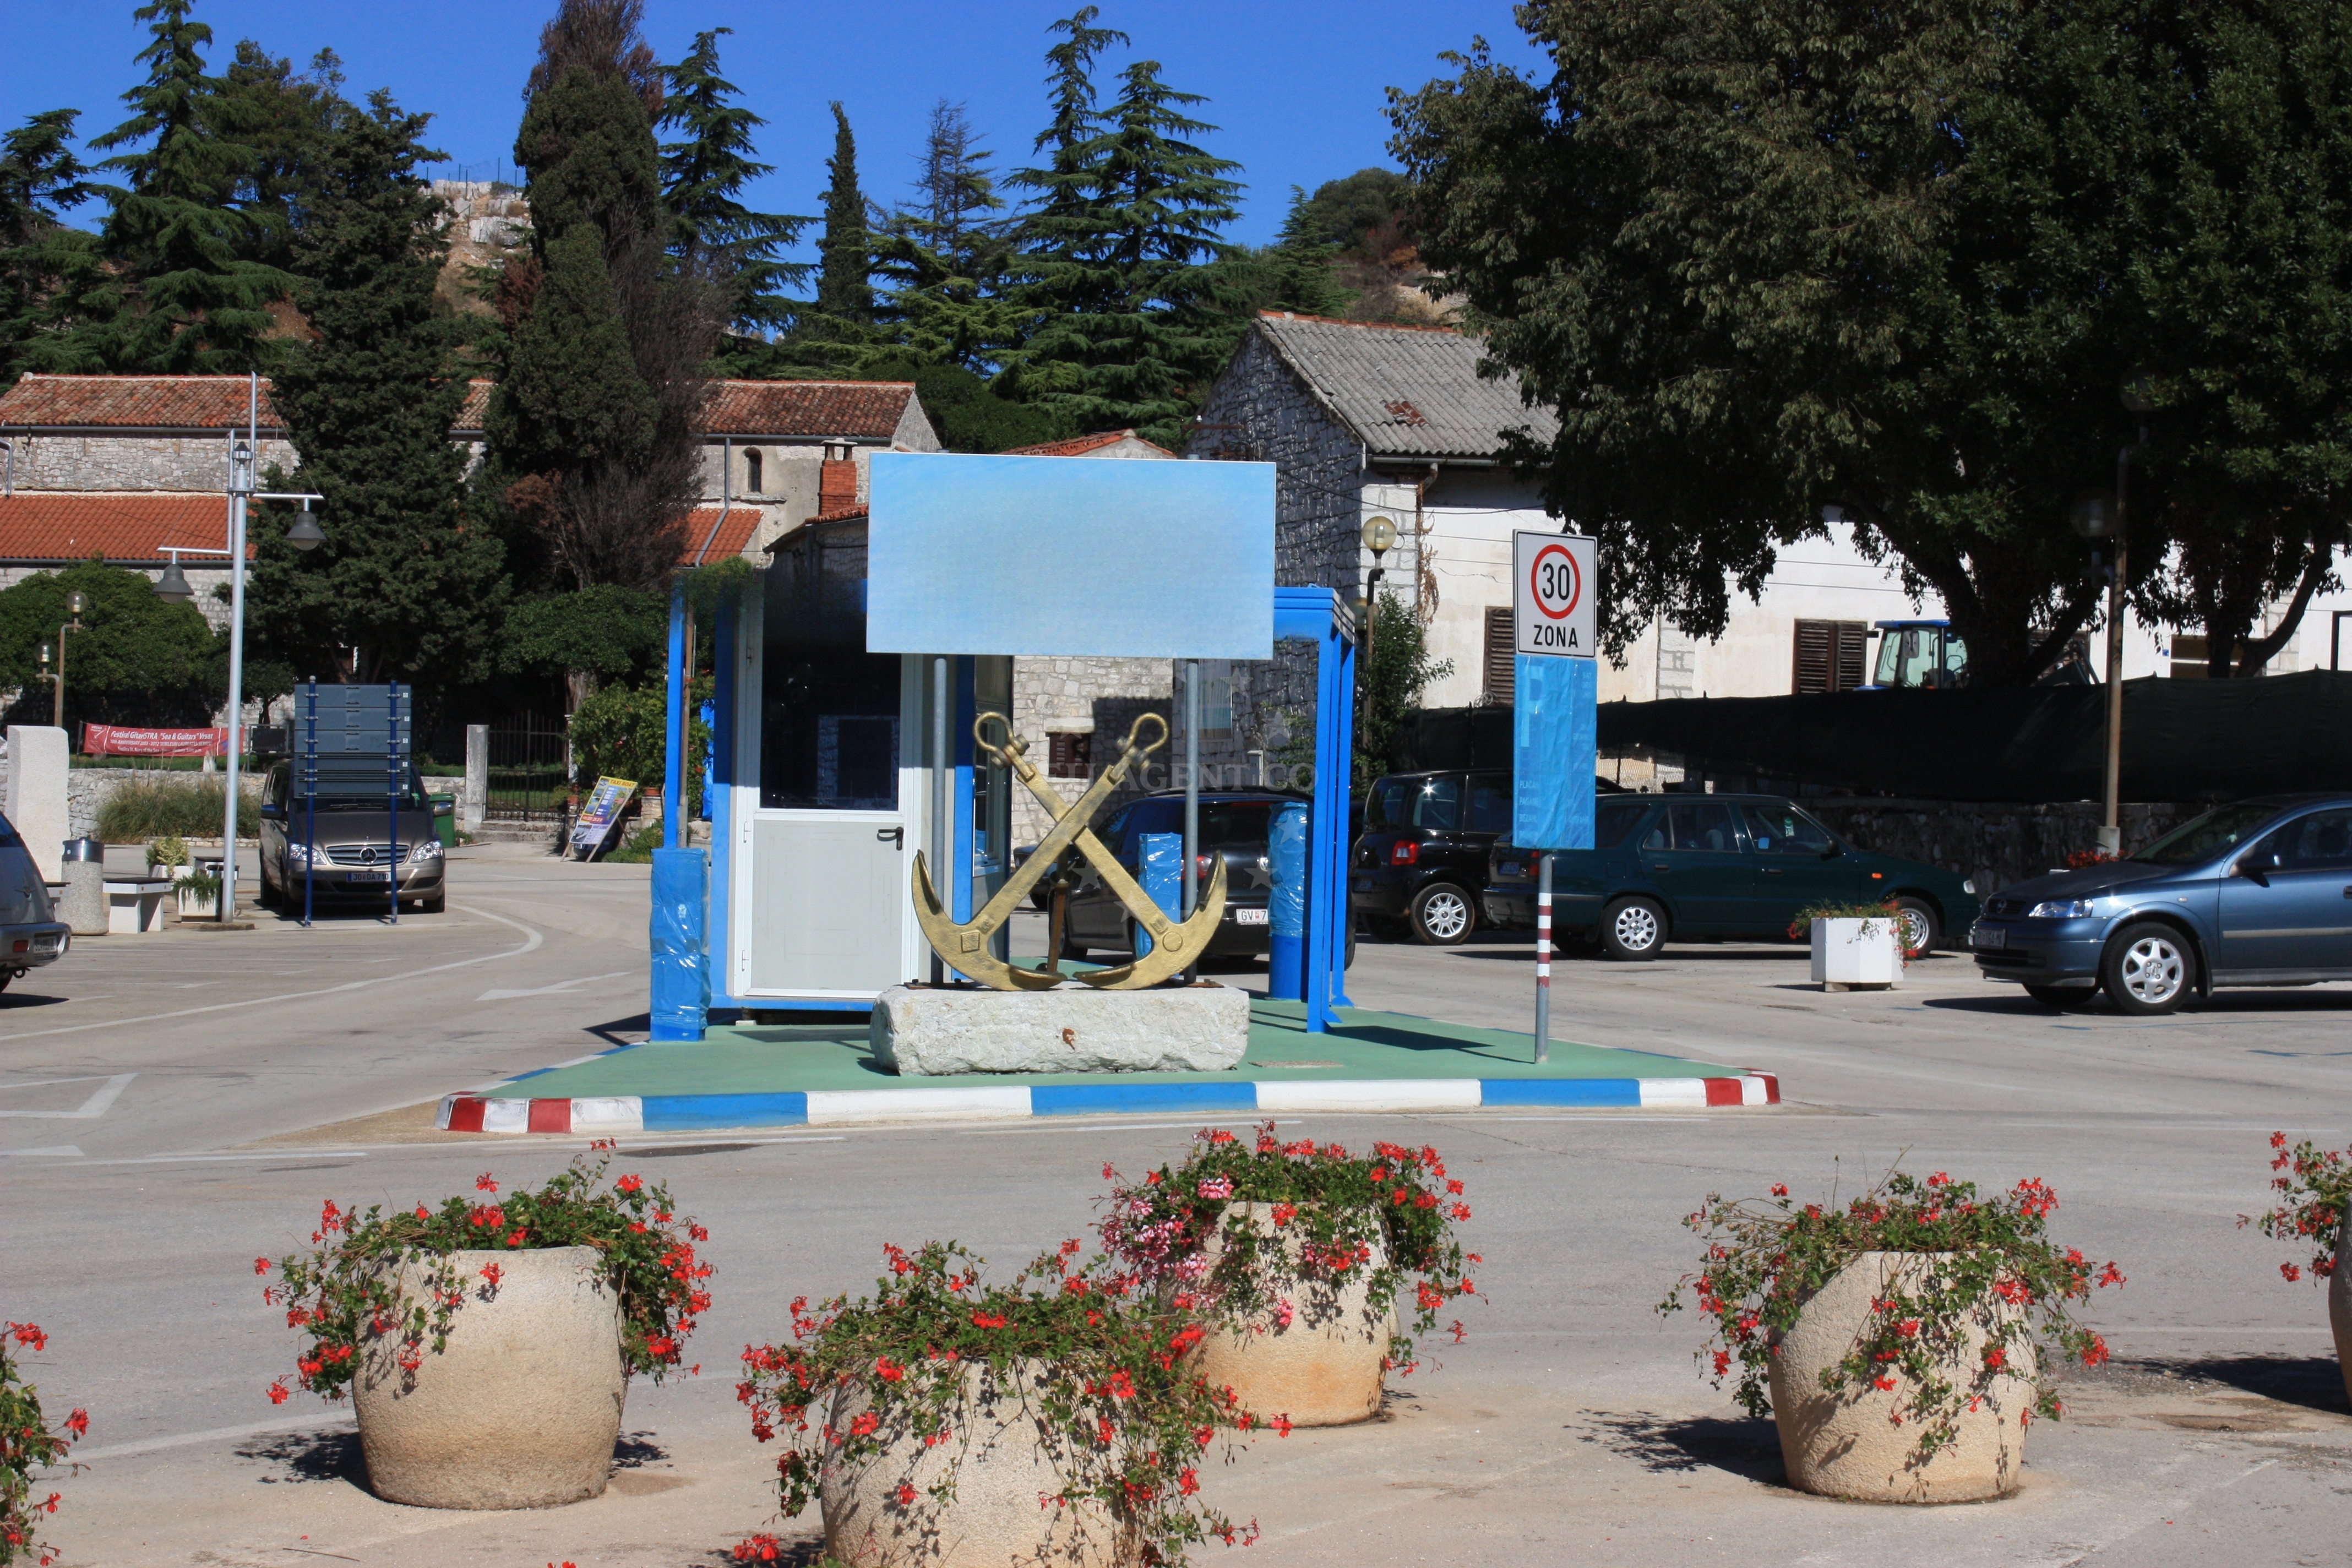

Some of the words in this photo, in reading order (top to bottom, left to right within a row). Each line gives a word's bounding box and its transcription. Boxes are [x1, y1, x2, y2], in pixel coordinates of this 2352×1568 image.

[1542, 563, 1570, 600] 30
[1533, 624, 1578, 648] ZONA
[1241, 911, 1253, 921] GV
